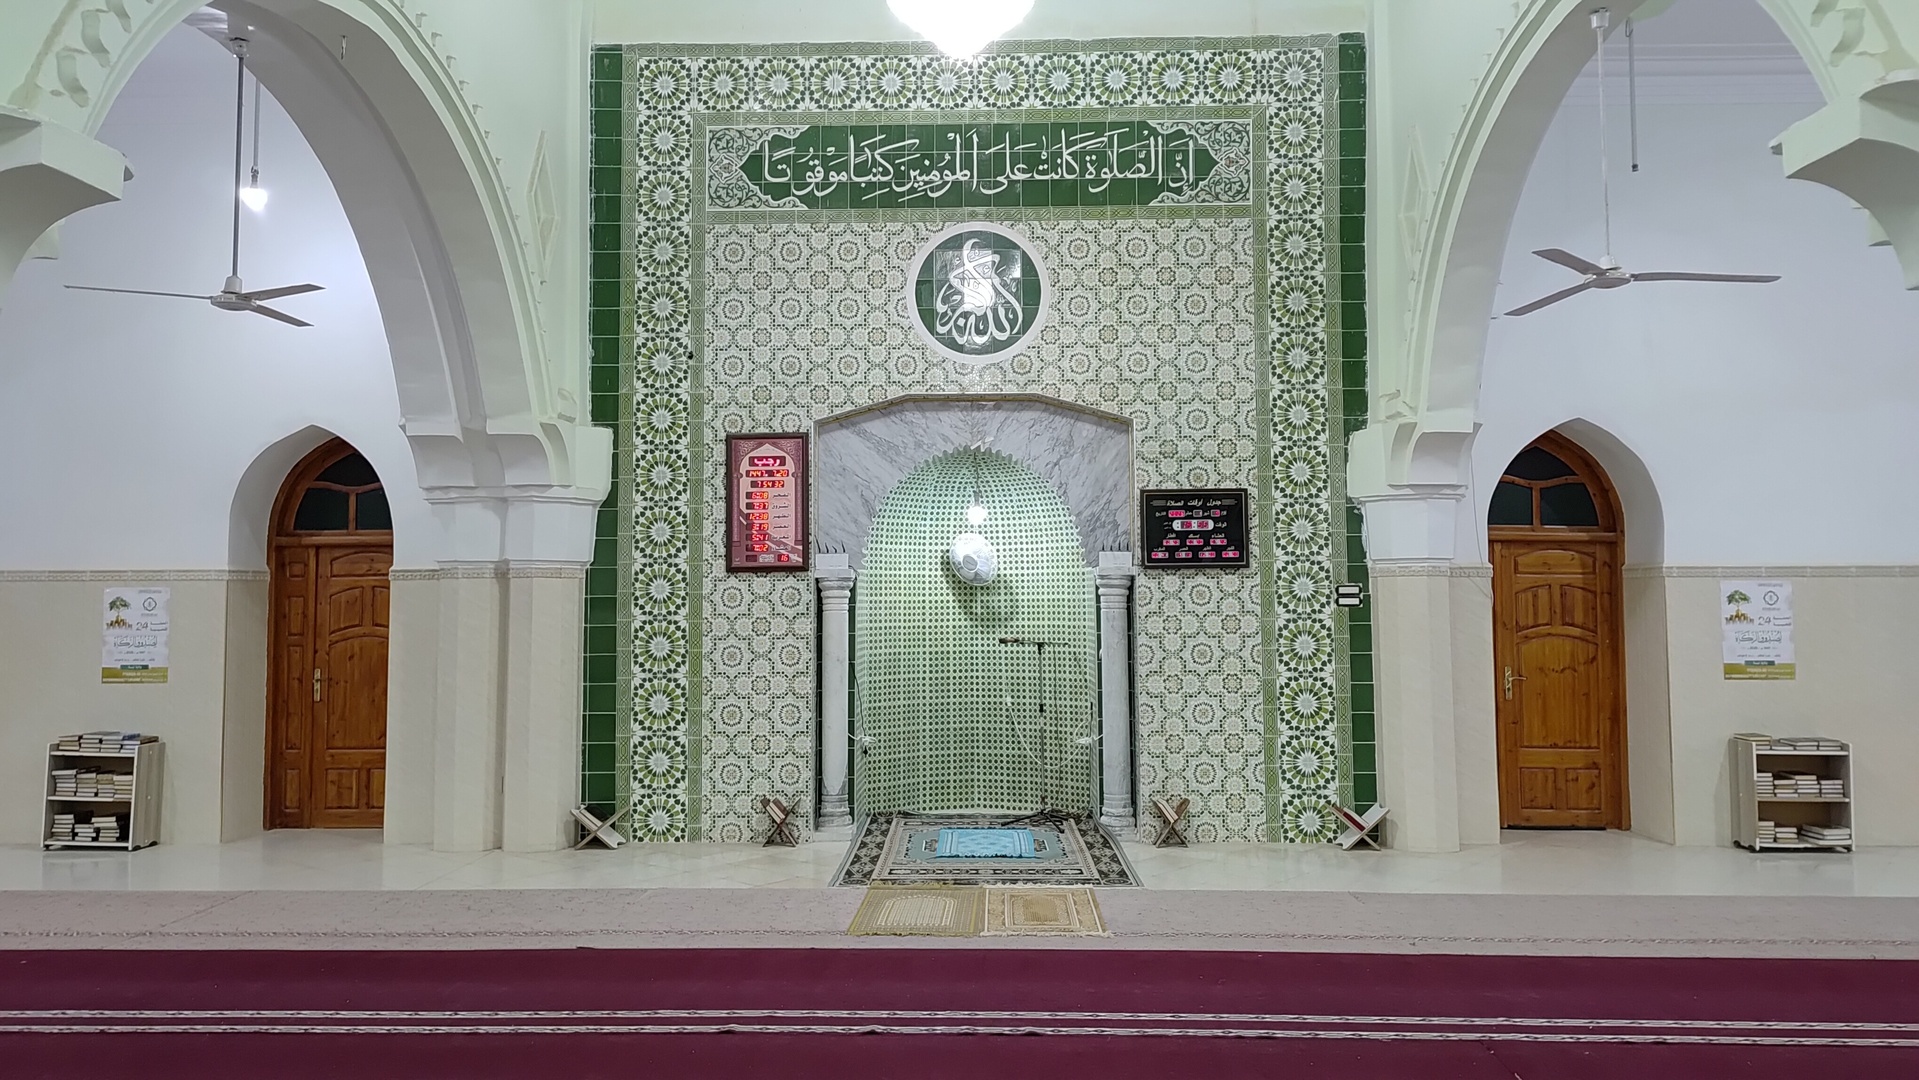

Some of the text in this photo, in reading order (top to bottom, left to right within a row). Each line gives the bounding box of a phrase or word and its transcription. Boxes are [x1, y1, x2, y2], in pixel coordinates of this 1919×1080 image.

[754, 458, 780, 467] رجب
[1758, 616, 1772, 626] 24
[136, 622, 148, 631] 24
